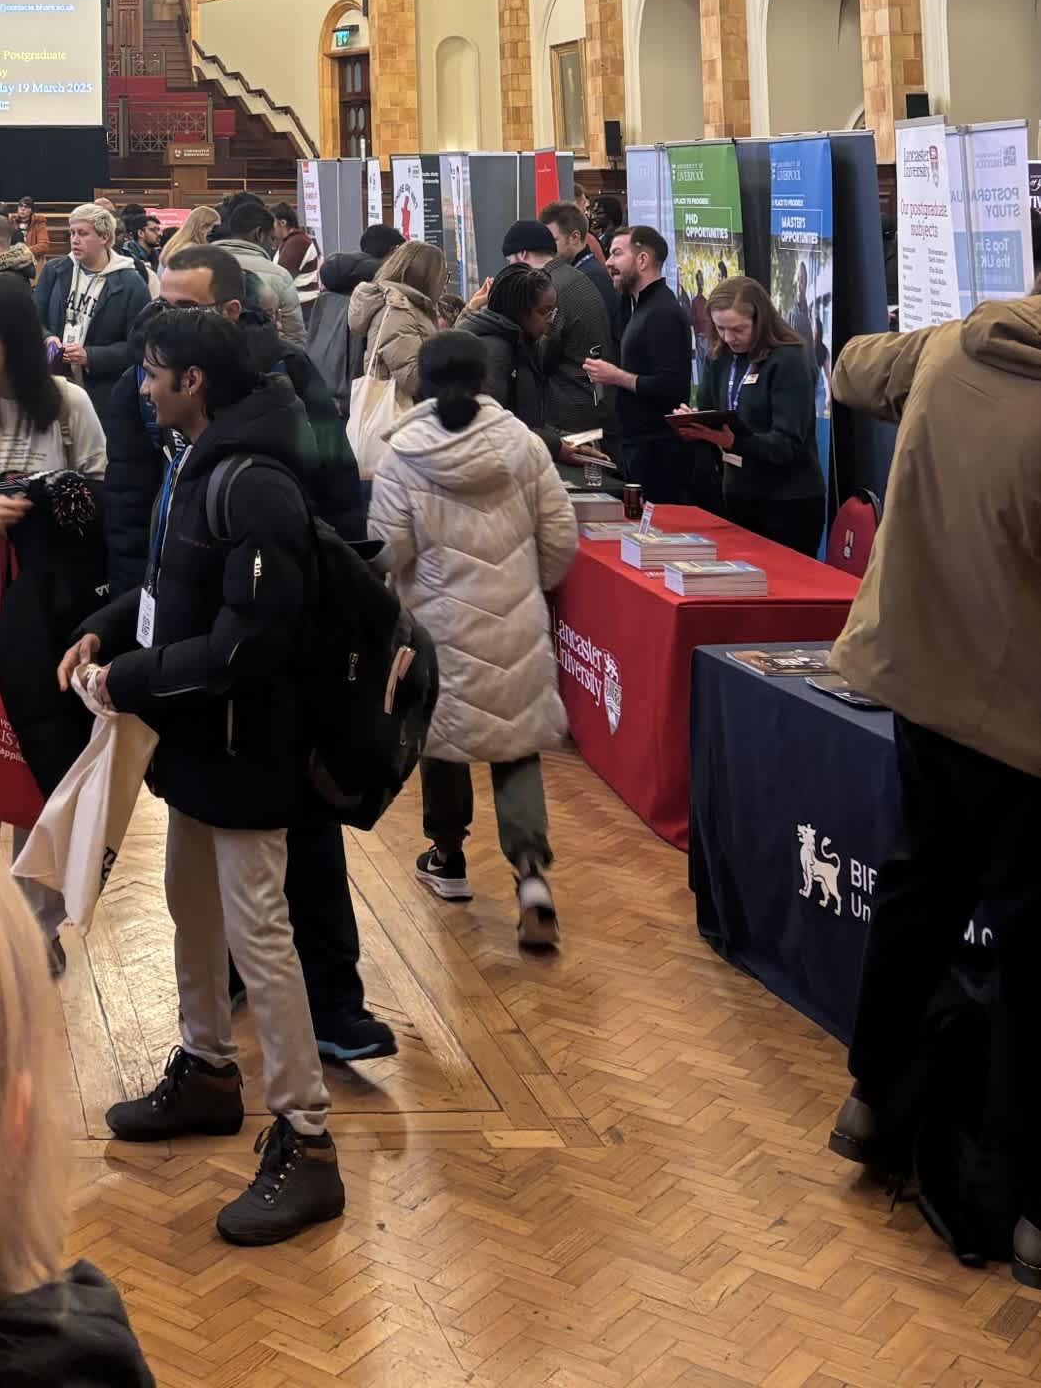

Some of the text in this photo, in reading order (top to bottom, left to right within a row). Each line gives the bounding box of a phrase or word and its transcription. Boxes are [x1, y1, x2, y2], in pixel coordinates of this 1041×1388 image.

[3, 50, 67, 62] Postgraduate
[18, 83, 29, 93] 19
[32, 83, 65, 93] March
[67, 83, 94, 93] 2025
[903, 147, 929, 162] Lancaster
[677, 170, 704, 181] LIVERPOOL
[776, 170, 801, 181] LIVERPOOL
[903, 162, 930, 181] University
[910, 200, 948, 219] postgraduate
[685, 213, 698, 224] PHD
[685, 226, 728, 239] OPPORTUNITIES
[910, 220, 938, 240] subjects
[781, 231, 819, 244] OPPORTUNITIES
[553, 606, 602, 672] Lancaster
[555, 634, 602, 707] University
